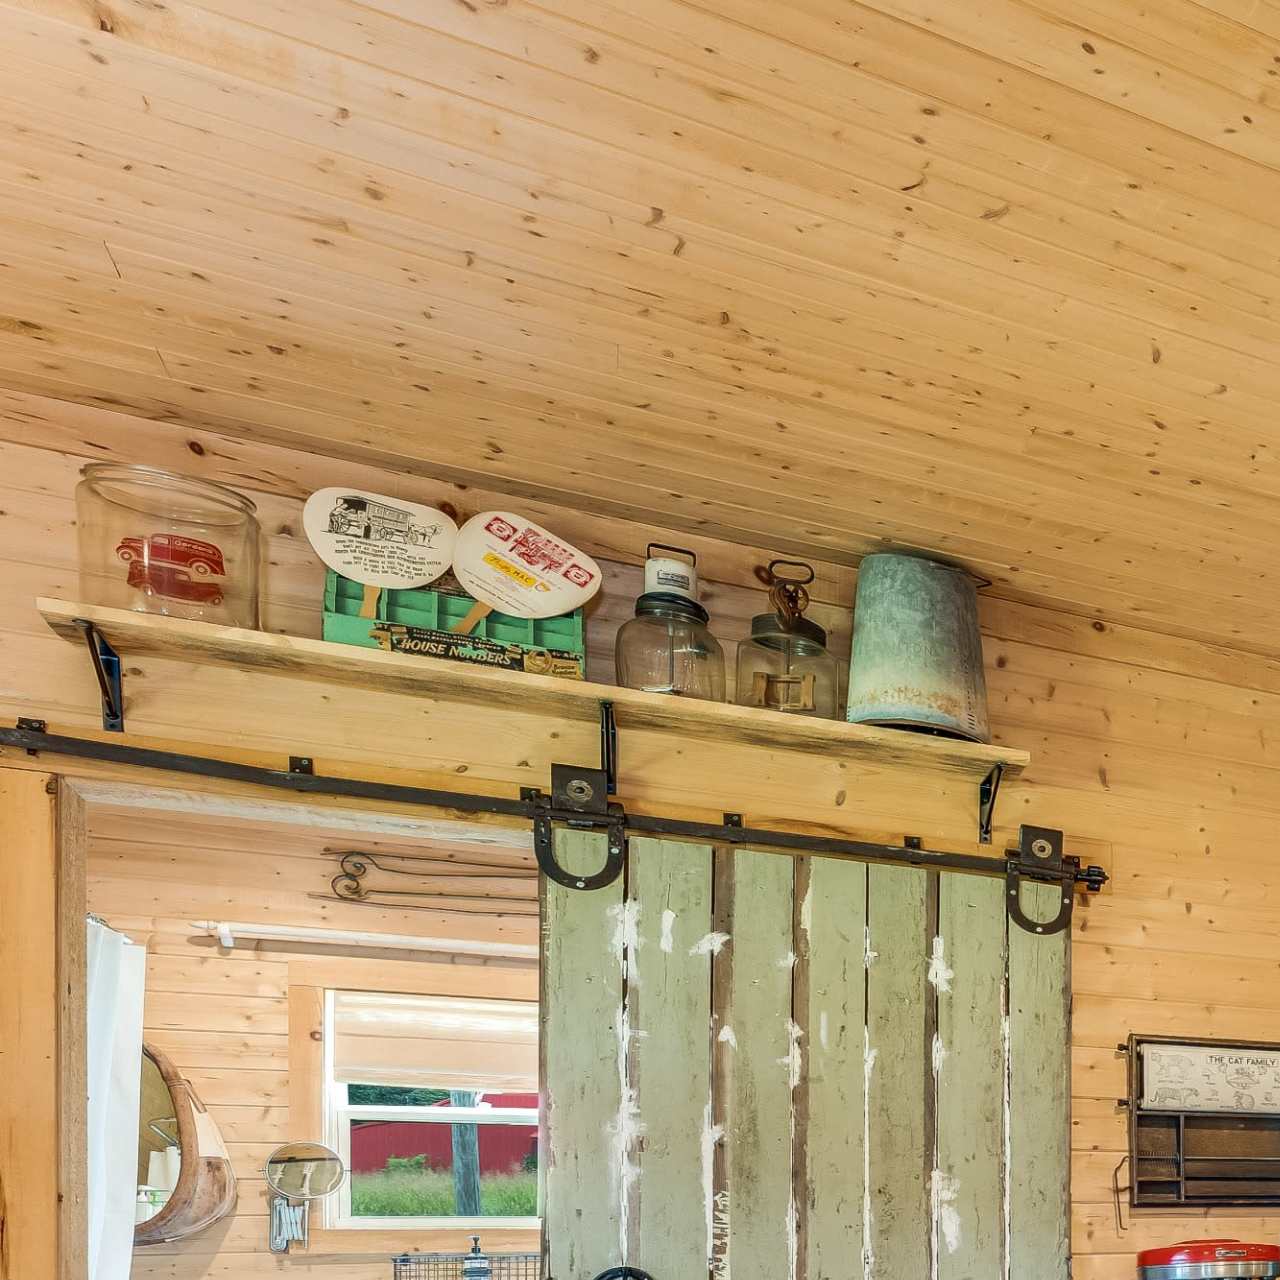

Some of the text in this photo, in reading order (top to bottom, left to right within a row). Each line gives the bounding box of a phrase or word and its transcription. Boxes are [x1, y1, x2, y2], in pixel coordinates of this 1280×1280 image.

[400, 638, 446, 655] HOUSE
[1209, 1055, 1276, 1066] THE CAT FAMILY
